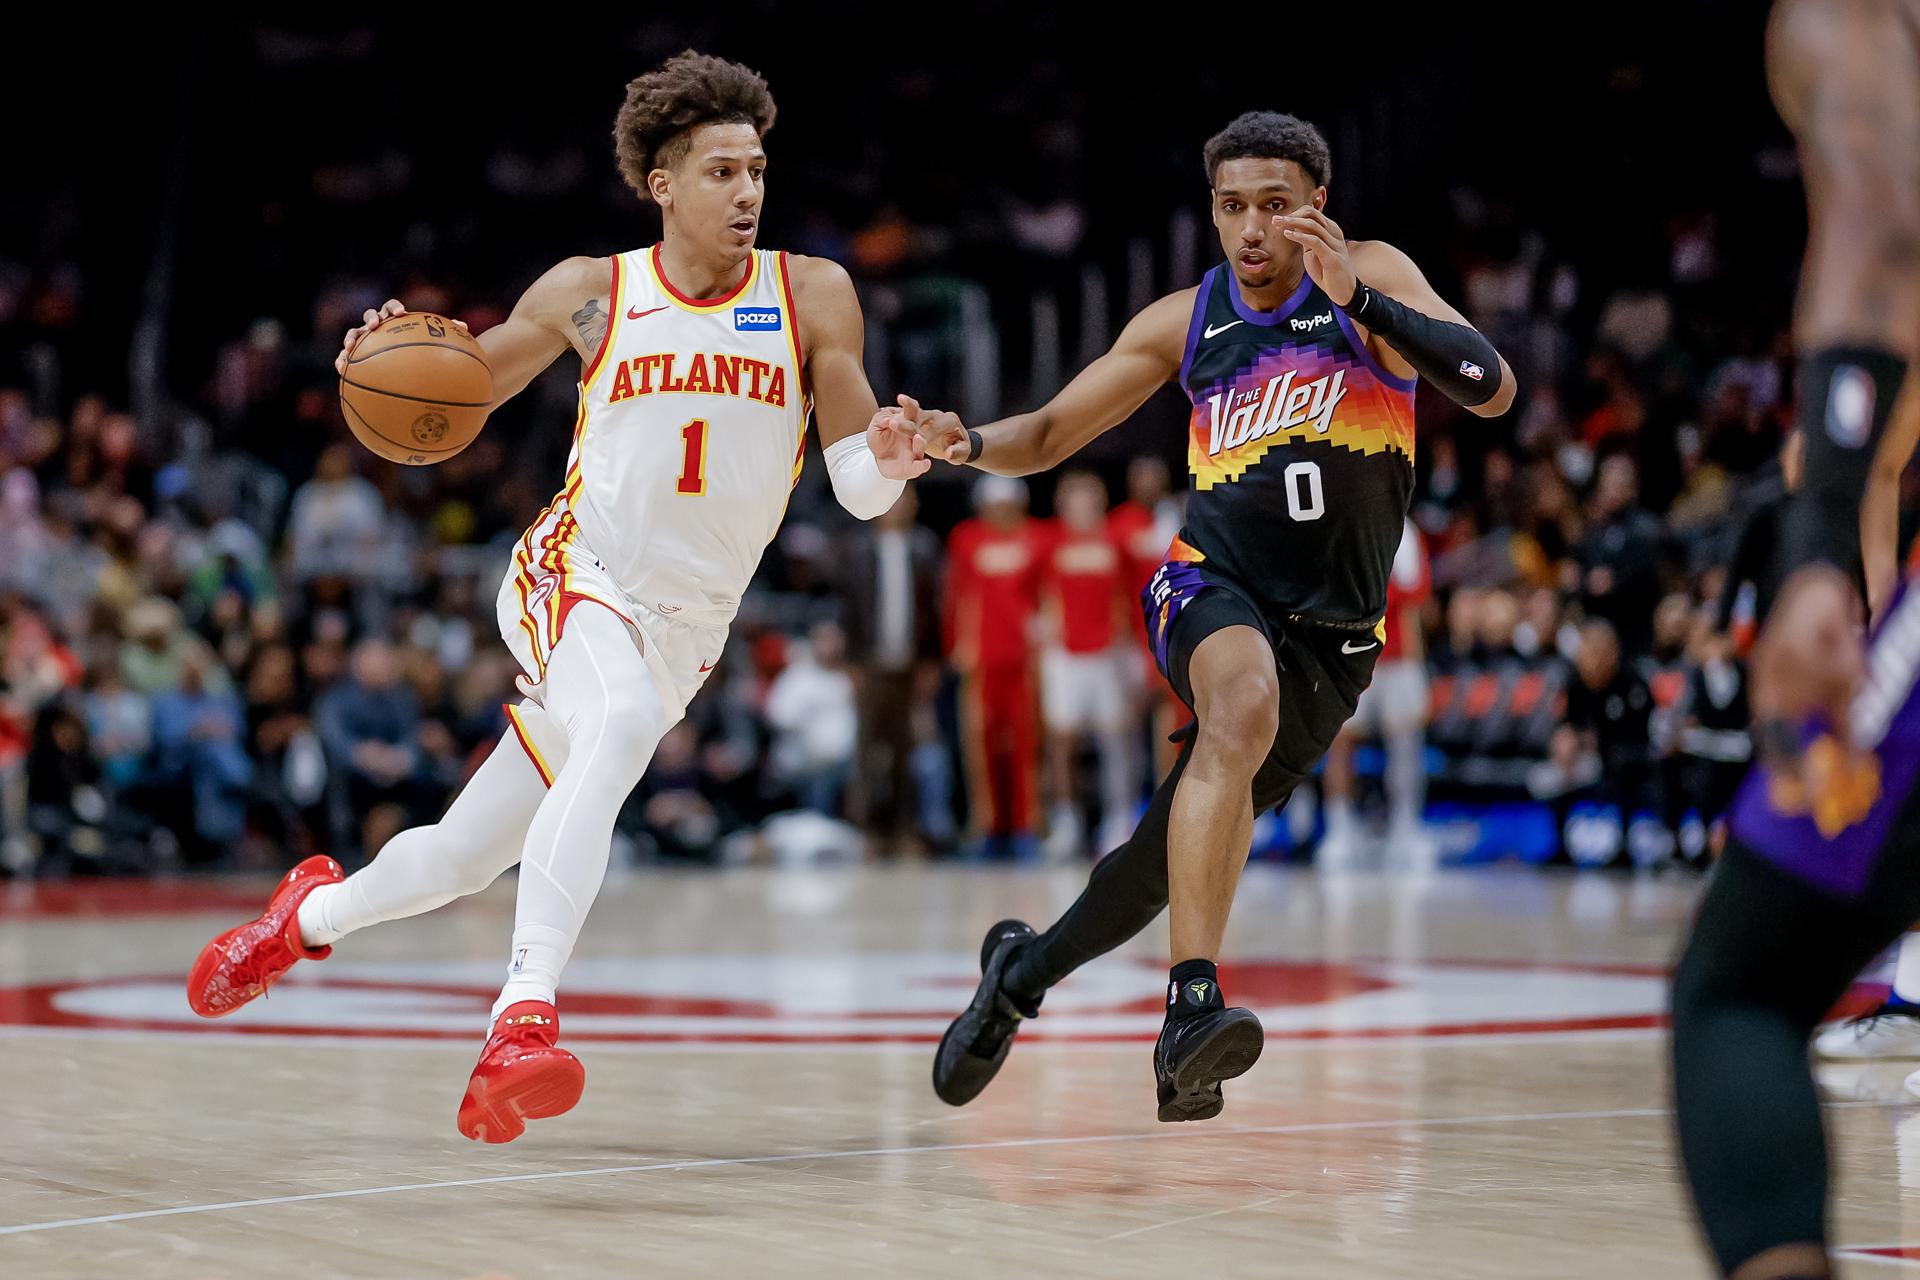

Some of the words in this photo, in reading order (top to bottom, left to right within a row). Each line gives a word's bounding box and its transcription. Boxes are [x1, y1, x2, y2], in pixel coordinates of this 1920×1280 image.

[737, 311, 778, 327] paze
[1290, 311, 1333, 332] PayPal
[608, 352, 786, 408] ATLANTA
[1236, 387, 1262, 406] THE
[1207, 368, 1348, 456] Valley
[676, 418, 709, 496] 1
[1284, 461, 1325, 521] 0
